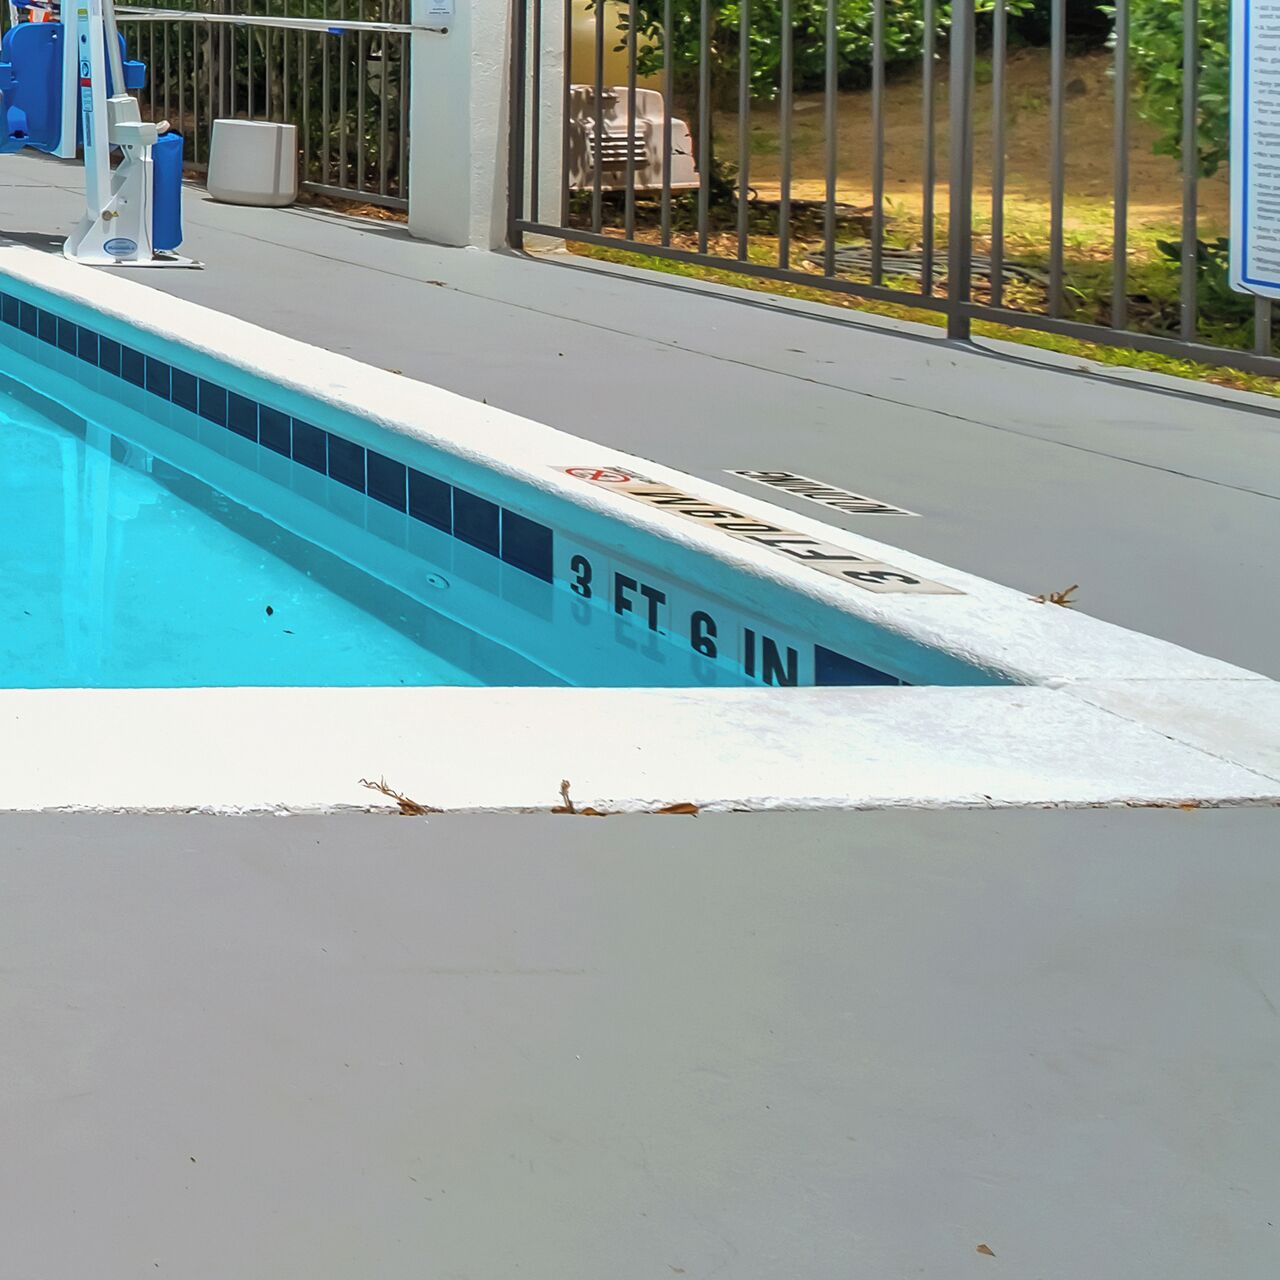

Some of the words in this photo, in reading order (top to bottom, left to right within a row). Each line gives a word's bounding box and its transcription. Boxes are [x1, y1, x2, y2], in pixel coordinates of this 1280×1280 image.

[738, 534, 863, 560] FT
[843, 569, 920, 587] 3
[570, 554, 593, 599] 3
[690, 610, 718, 659] 6
[744, 627, 799, 688] IN
